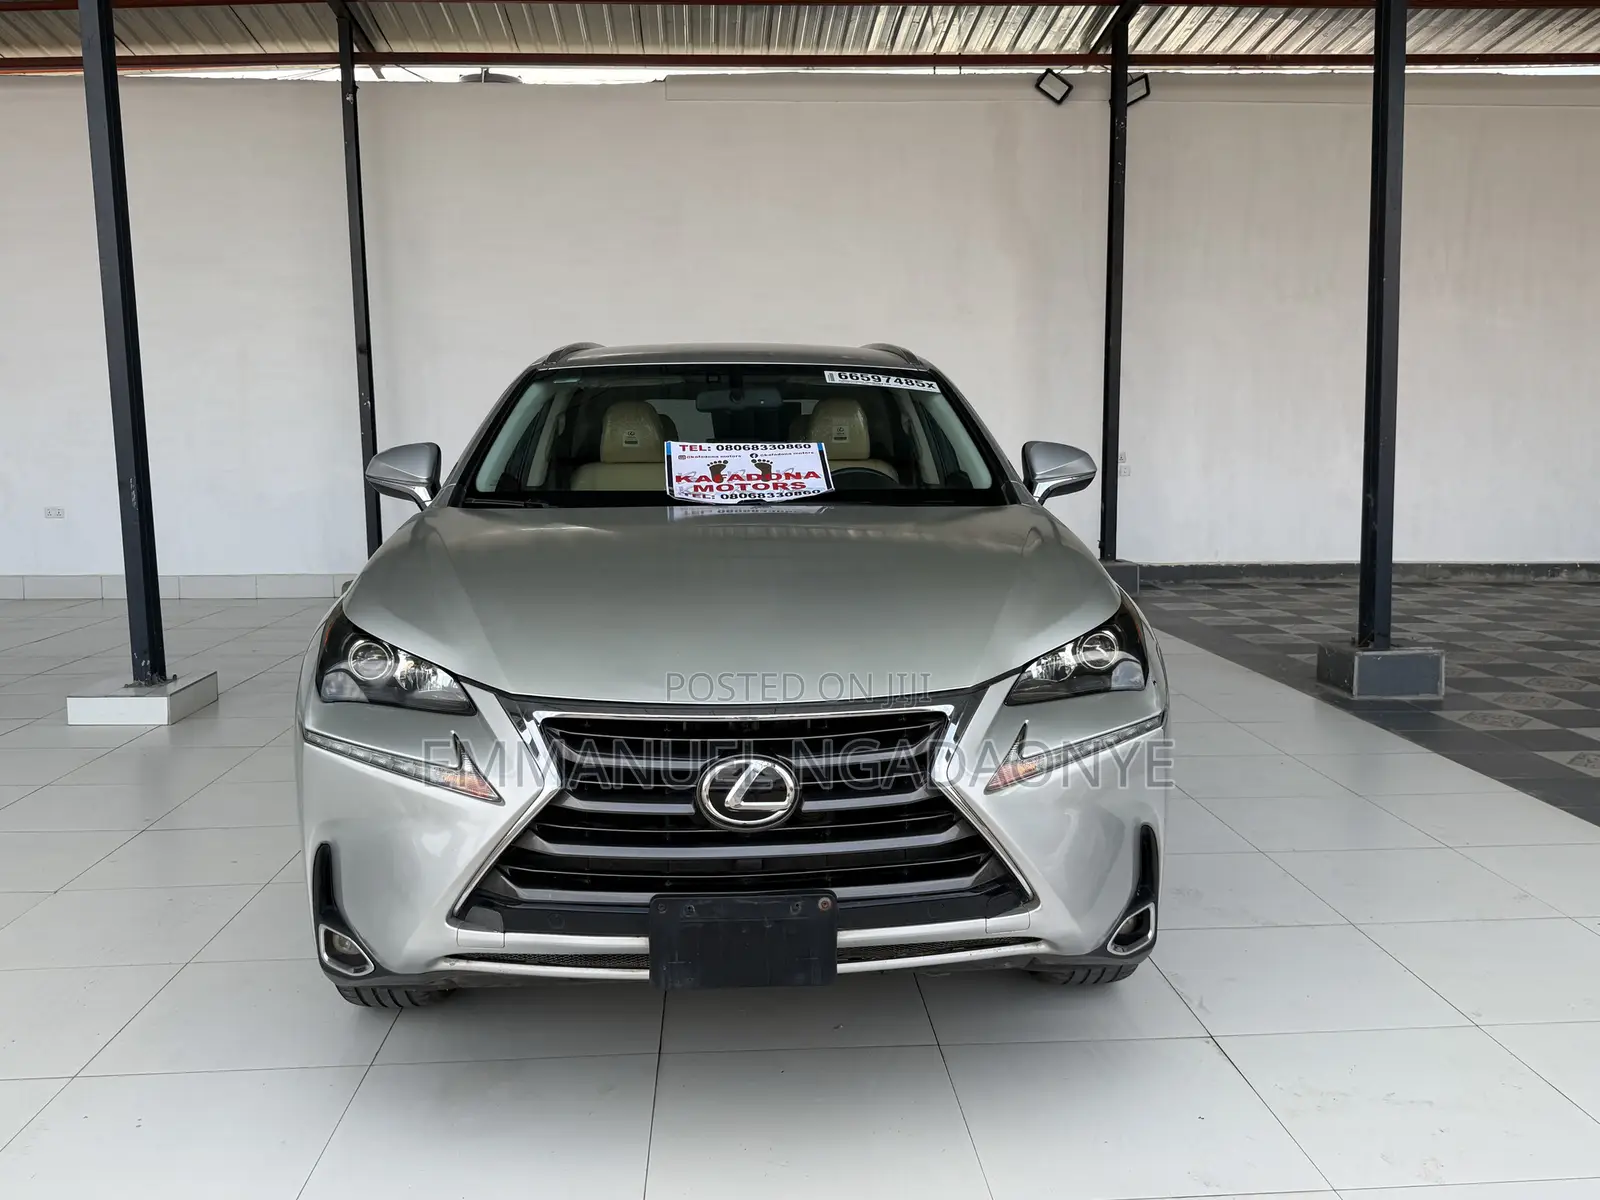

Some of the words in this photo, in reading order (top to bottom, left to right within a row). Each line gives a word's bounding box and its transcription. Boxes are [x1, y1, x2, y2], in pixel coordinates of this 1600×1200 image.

[679, 444, 711, 452] TEL:
[716, 443, 812, 452] 08068330860
[694, 482, 806, 493] MOTORS
[683, 492, 715, 500] TEL:
[720, 489, 821, 500] 08068330860
